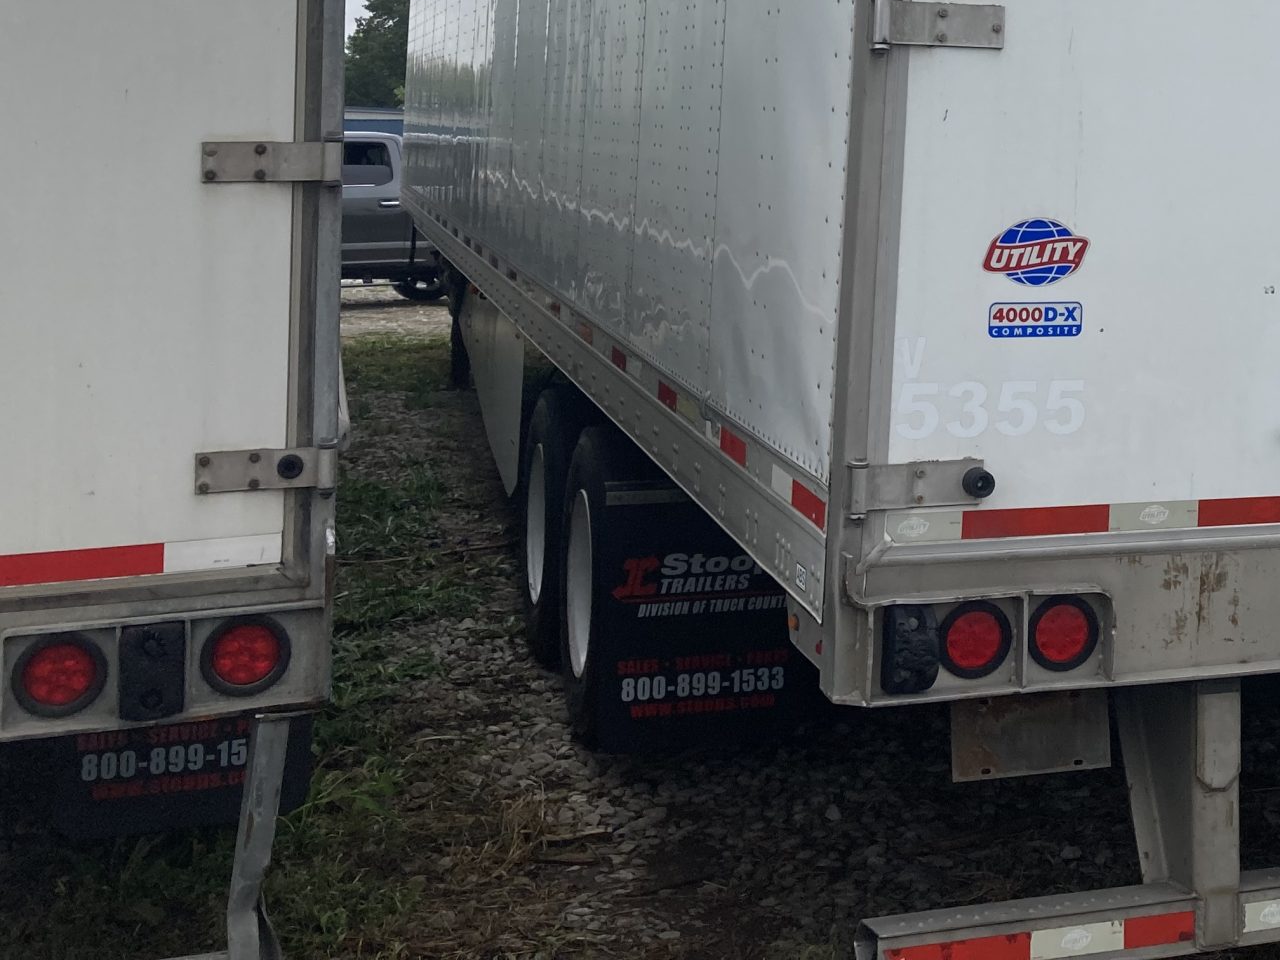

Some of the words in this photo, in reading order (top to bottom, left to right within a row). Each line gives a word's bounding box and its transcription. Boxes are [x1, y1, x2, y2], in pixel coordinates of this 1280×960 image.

[990, 241, 1083, 270] UTILITY
[992, 306, 1078, 324] 4000D-X
[992, 327, 1078, 337] COMPOSITE
[895, 379, 1087, 440] 5355
[661, 553, 764, 575] Stoo
[660, 574, 751, 595] TRAILERS
[637, 602, 689, 618] DIVISION
[692, 601, 706, 614] OF
[709, 598, 744, 613] TRUCK
[621, 666, 785, 702] 800-899-1533
